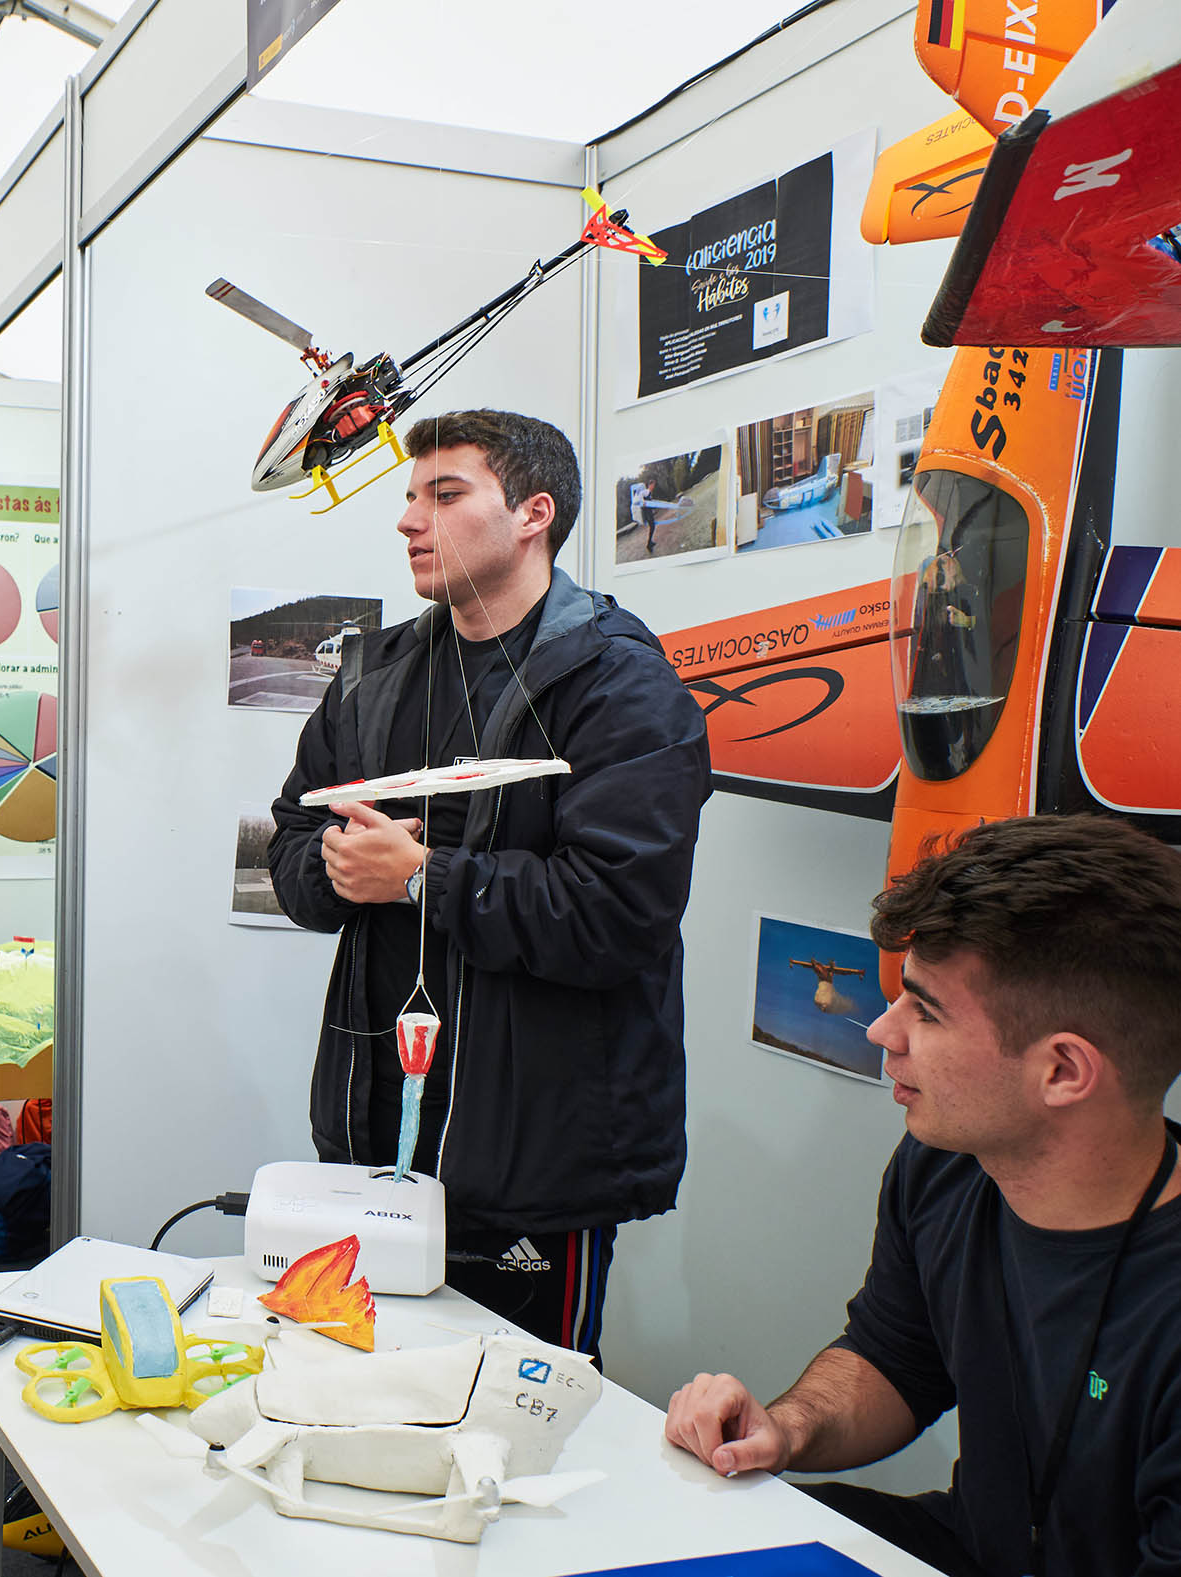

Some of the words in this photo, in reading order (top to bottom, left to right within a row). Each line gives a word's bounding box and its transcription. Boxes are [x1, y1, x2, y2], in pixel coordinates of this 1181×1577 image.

[744, 243, 777, 271] 2019
[1004, 349, 1029, 411] 342
[34, 495, 52, 513] ás
[34, 533, 51, 544] Que
[22, 665, 28, 673] a
[364, 1210, 414, 1221] ABOX
[515, 1391, 559, 1422] CB7
